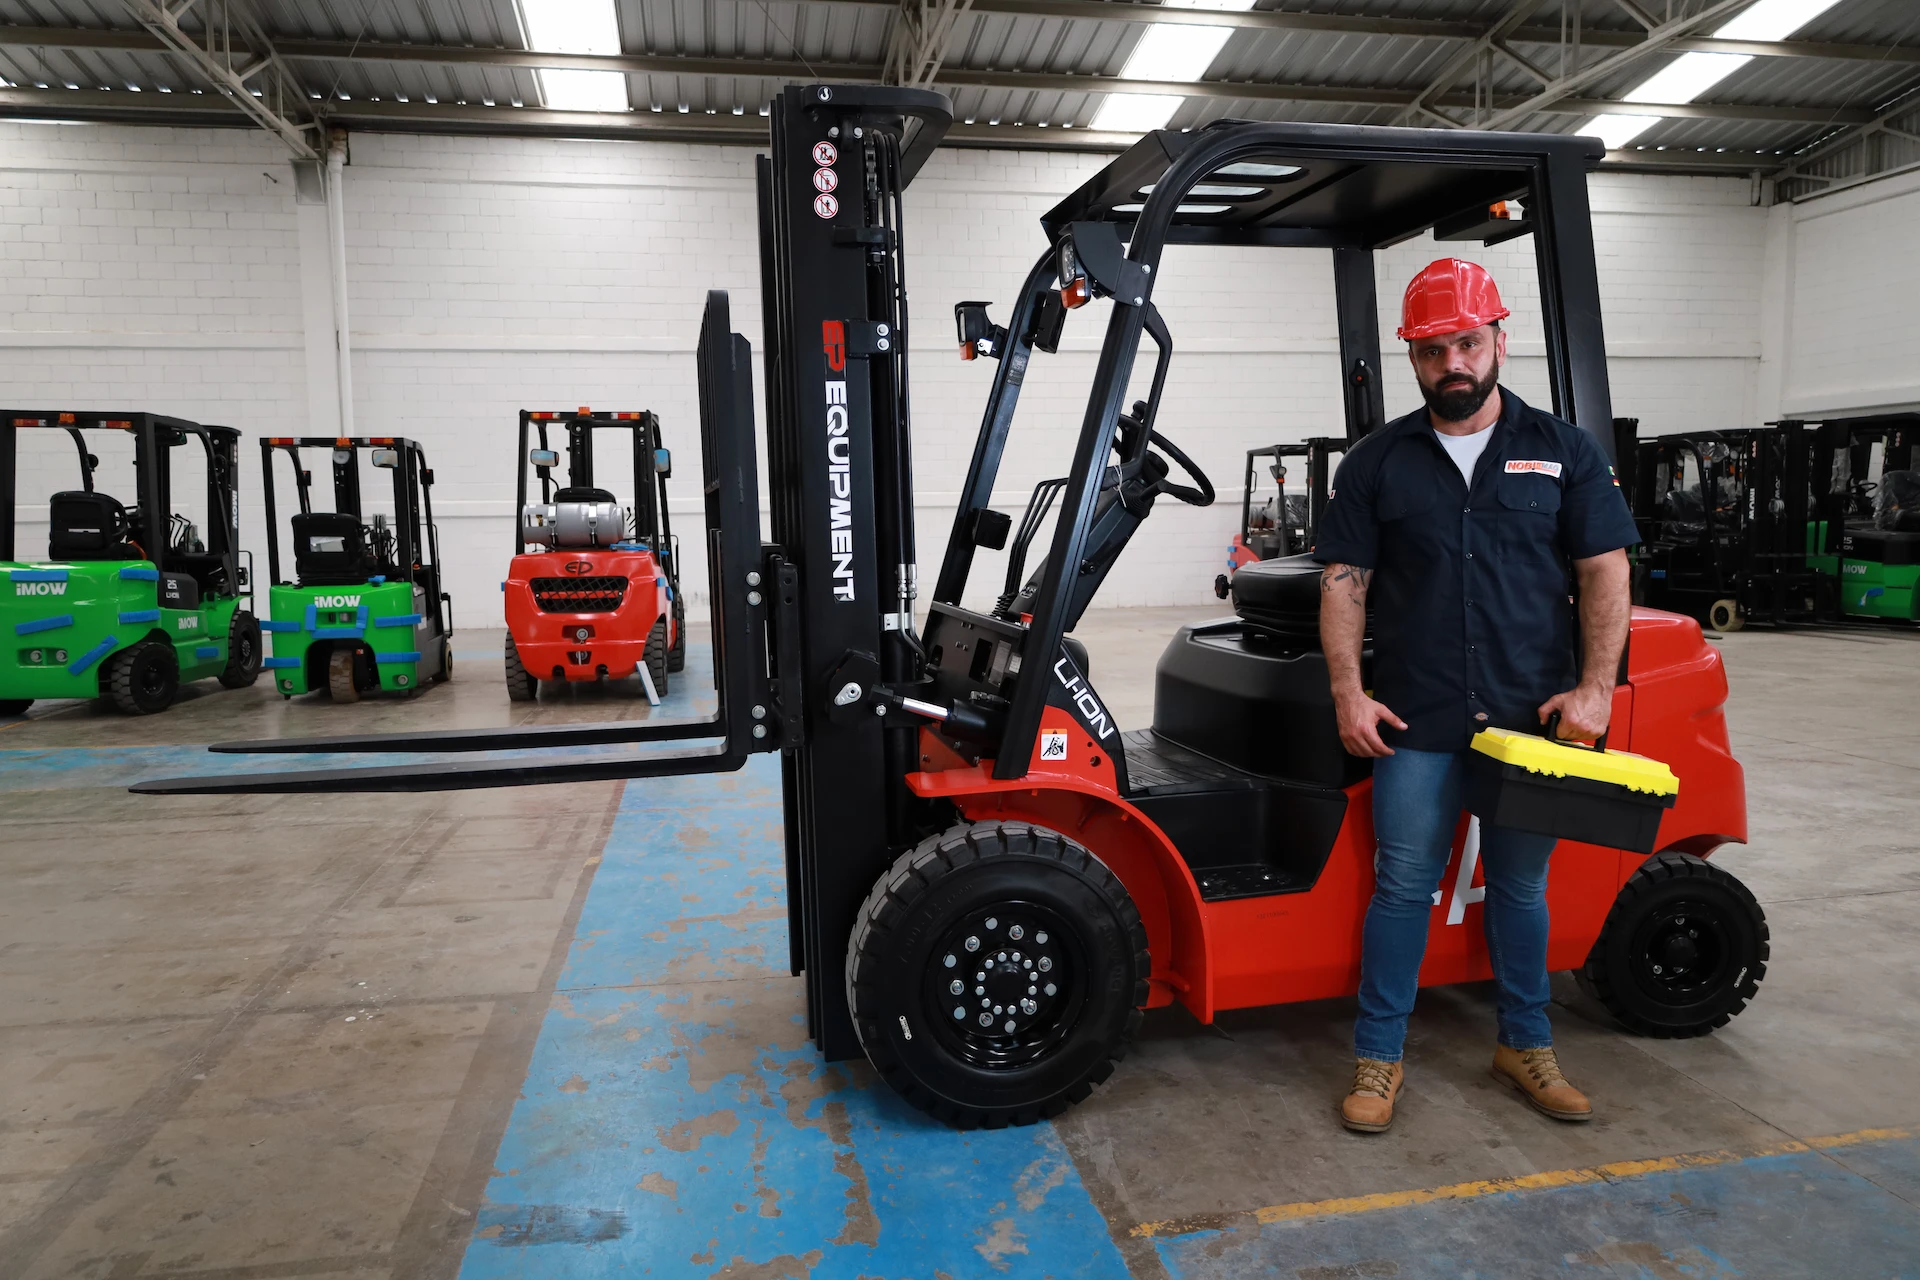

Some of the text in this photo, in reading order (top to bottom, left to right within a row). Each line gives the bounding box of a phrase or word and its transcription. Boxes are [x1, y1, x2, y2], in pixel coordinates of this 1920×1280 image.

[822, 320, 856, 601] EP EQUIPMENT
[1843, 564, 1867, 574] MOW
[314, 595, 361, 608] iMOW
[1054, 657, 1115, 741] LI-ION
